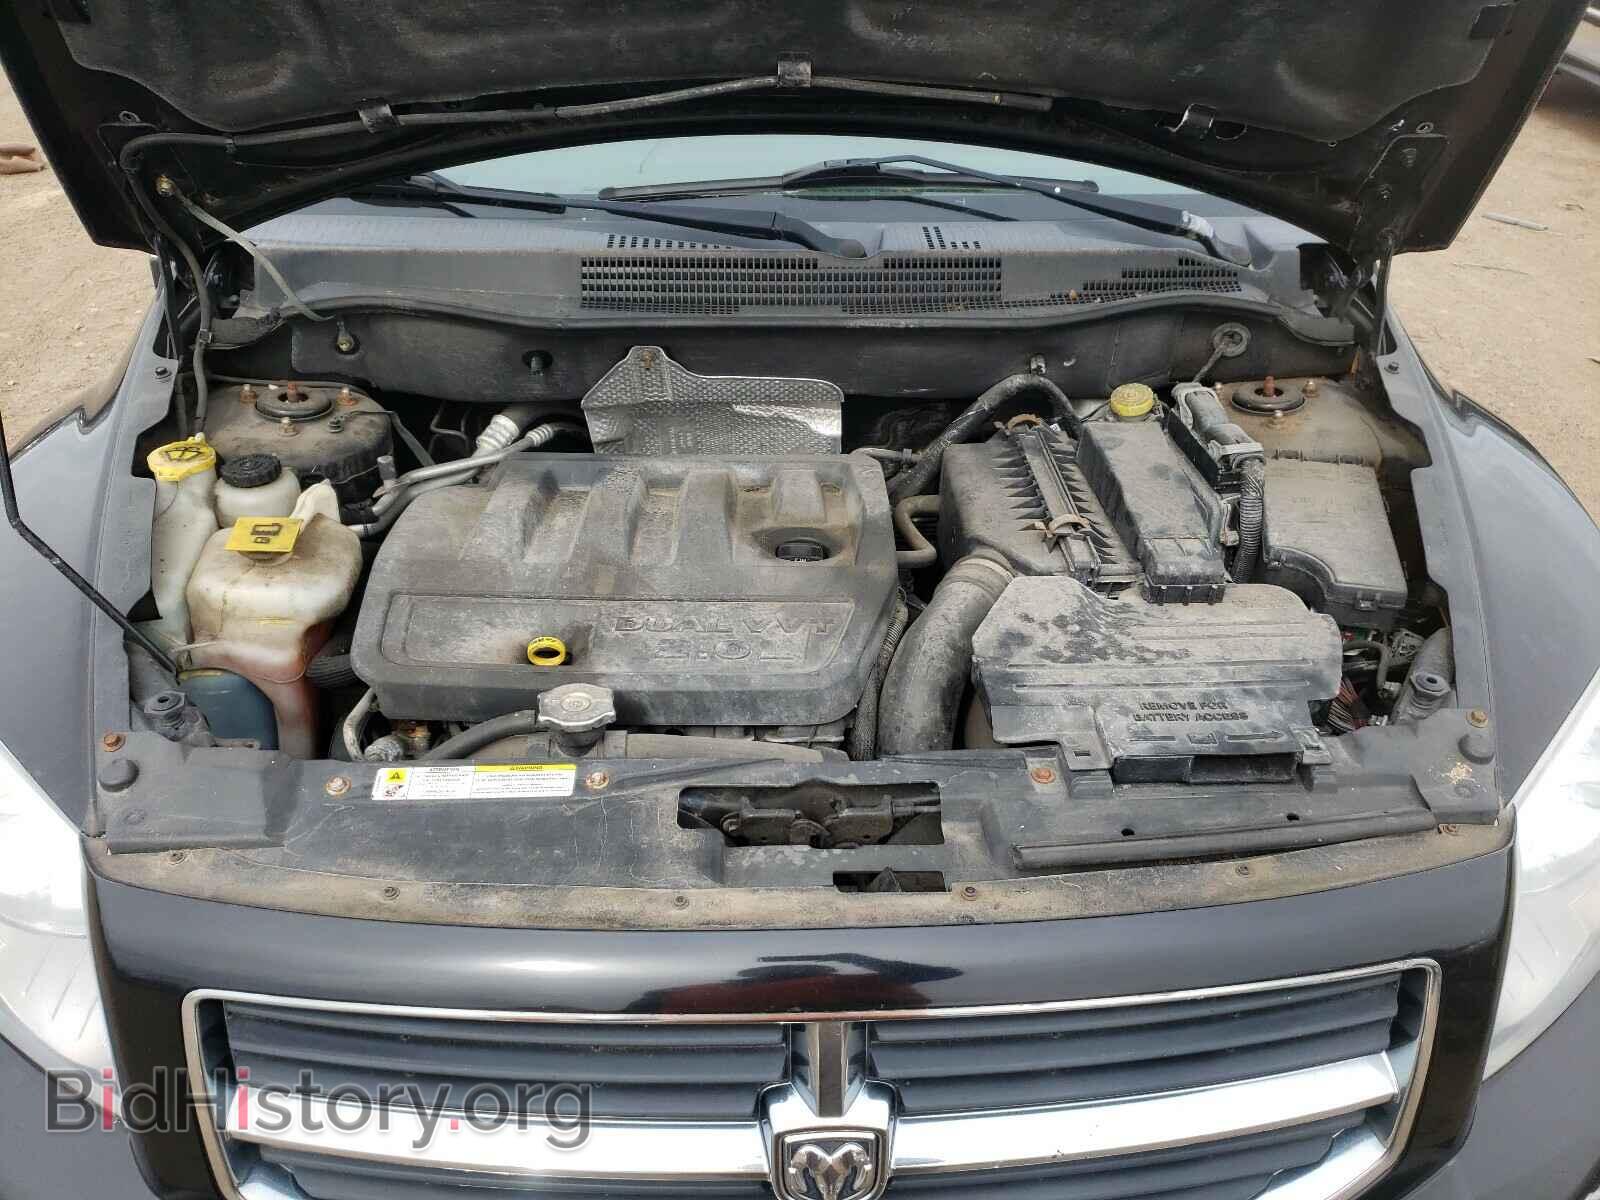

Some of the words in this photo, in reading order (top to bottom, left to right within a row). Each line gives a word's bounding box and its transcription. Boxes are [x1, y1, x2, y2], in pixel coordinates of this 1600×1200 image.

[610, 614, 733, 633] DUAL
[743, 611, 835, 634] VVT
[1139, 702, 1197, 711] REMOVE
[1200, 701, 1228, 710] FOR
[1133, 712, 1190, 721] BATTERY
[1195, 712, 1248, 721] ACCESS
